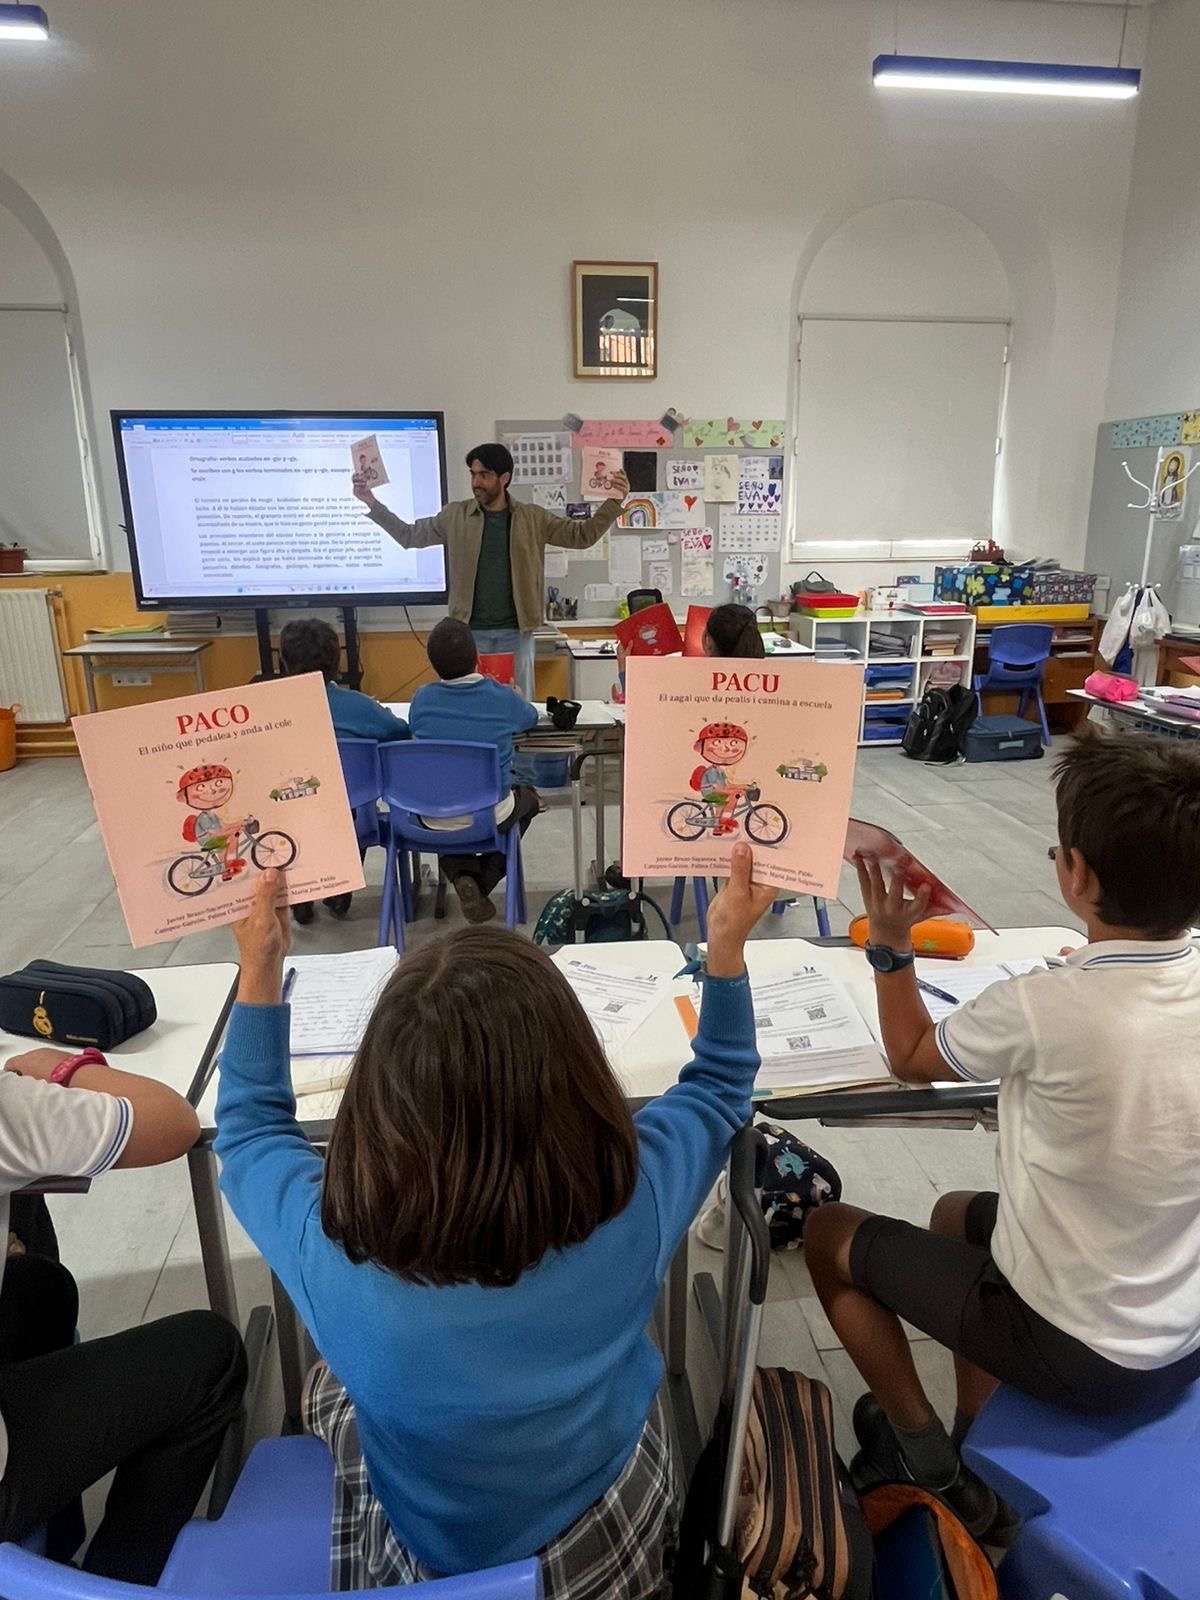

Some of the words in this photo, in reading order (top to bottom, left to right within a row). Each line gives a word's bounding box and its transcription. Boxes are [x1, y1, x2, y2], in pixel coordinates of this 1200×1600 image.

[738, 490, 761, 501] EVA
[711, 671, 781, 693] PACU
[659, 693, 668, 702] El
[669, 694, 692, 704] zagal
[694, 696, 711, 705] que
[712, 694, 723, 703] da
[757, 697, 791, 707] camina
[799, 700, 833, 710] escuela
[175, 704, 251, 736] PACO
[138, 746, 149, 756] El
[151, 742, 174, 753] niño
[175, 739, 194, 750] que
[195, 732, 231, 747] pedalea
[232, 731, 239, 740] y
[240, 725, 263, 737] anda
[264, 723, 273, 731] al
[274, 719, 293, 729] cole
